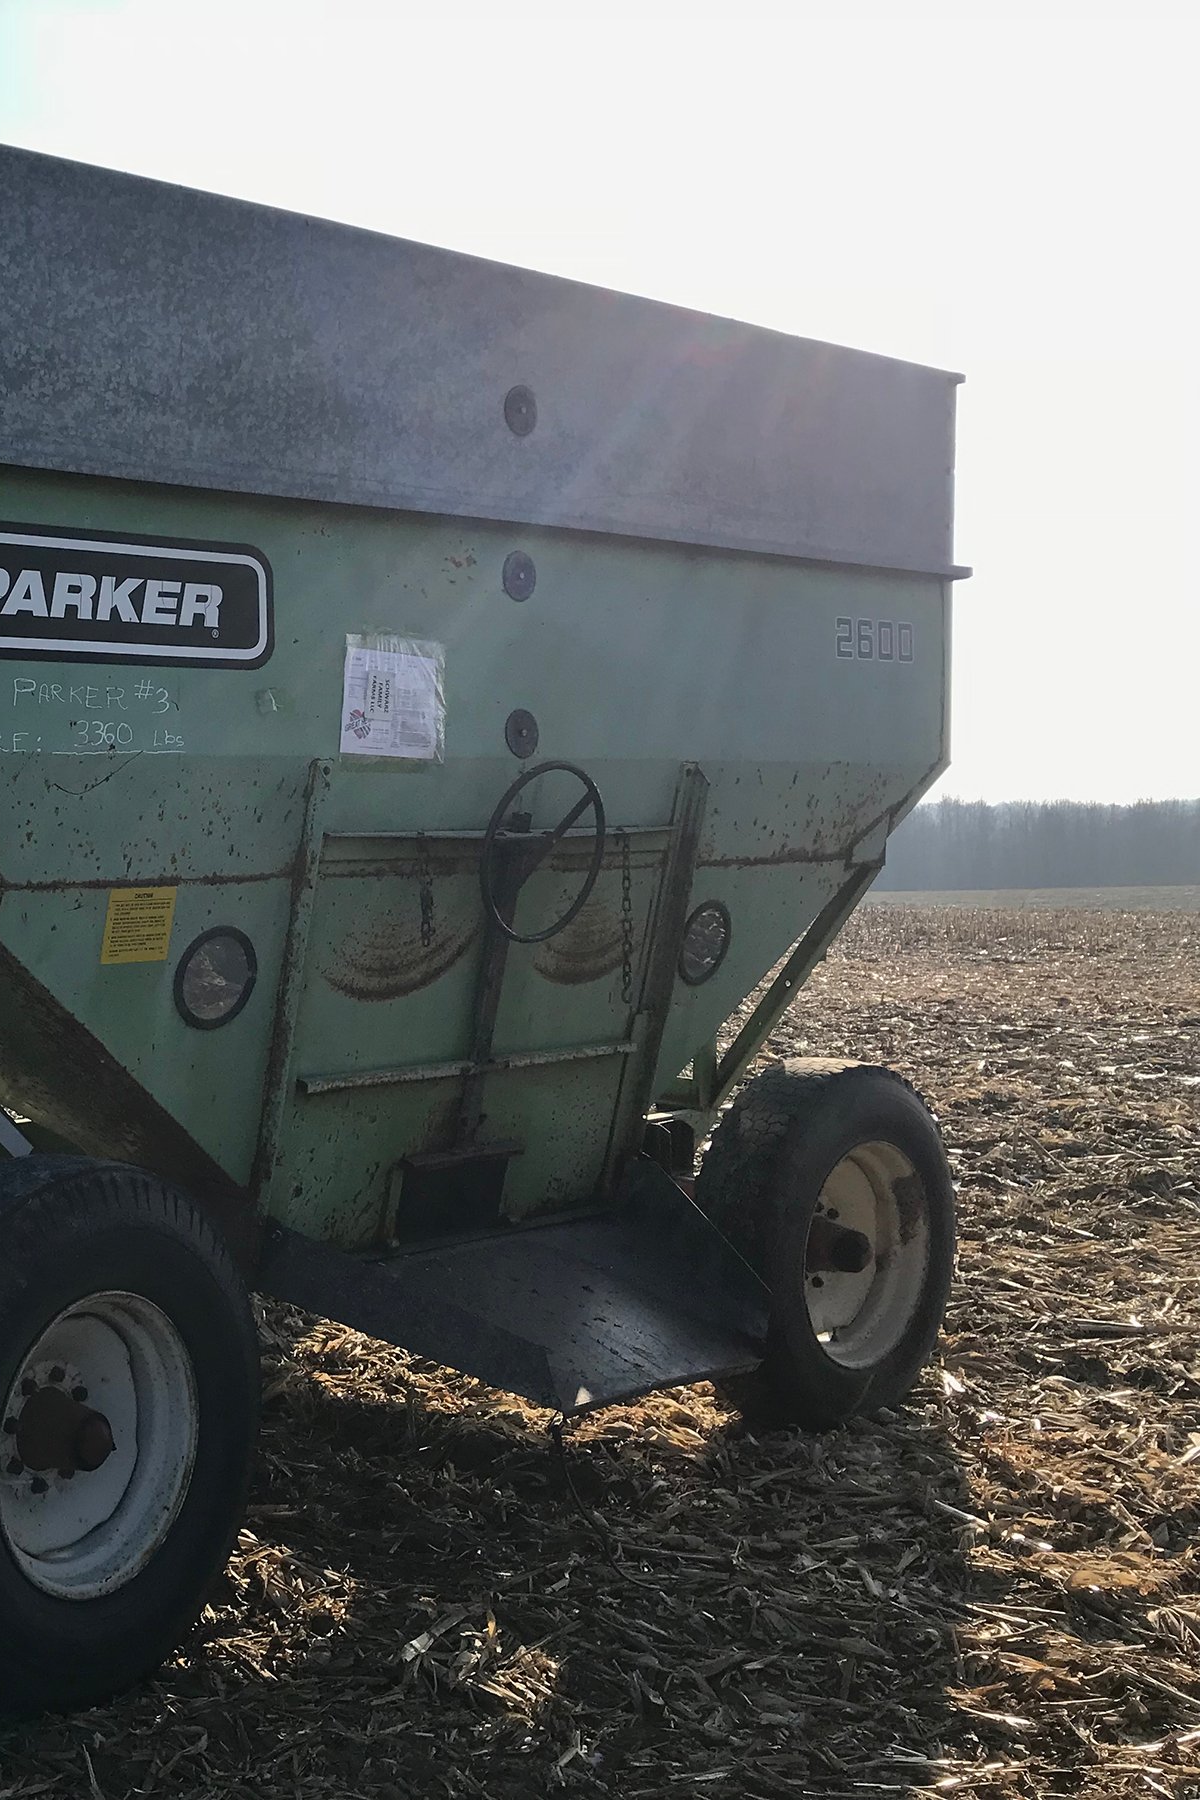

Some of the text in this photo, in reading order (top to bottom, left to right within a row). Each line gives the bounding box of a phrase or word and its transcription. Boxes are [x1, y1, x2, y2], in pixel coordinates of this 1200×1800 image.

[835, 616, 914, 664] 2600
[13, 677, 129, 711] PARKER
[72, 719, 134, 748] 3360
